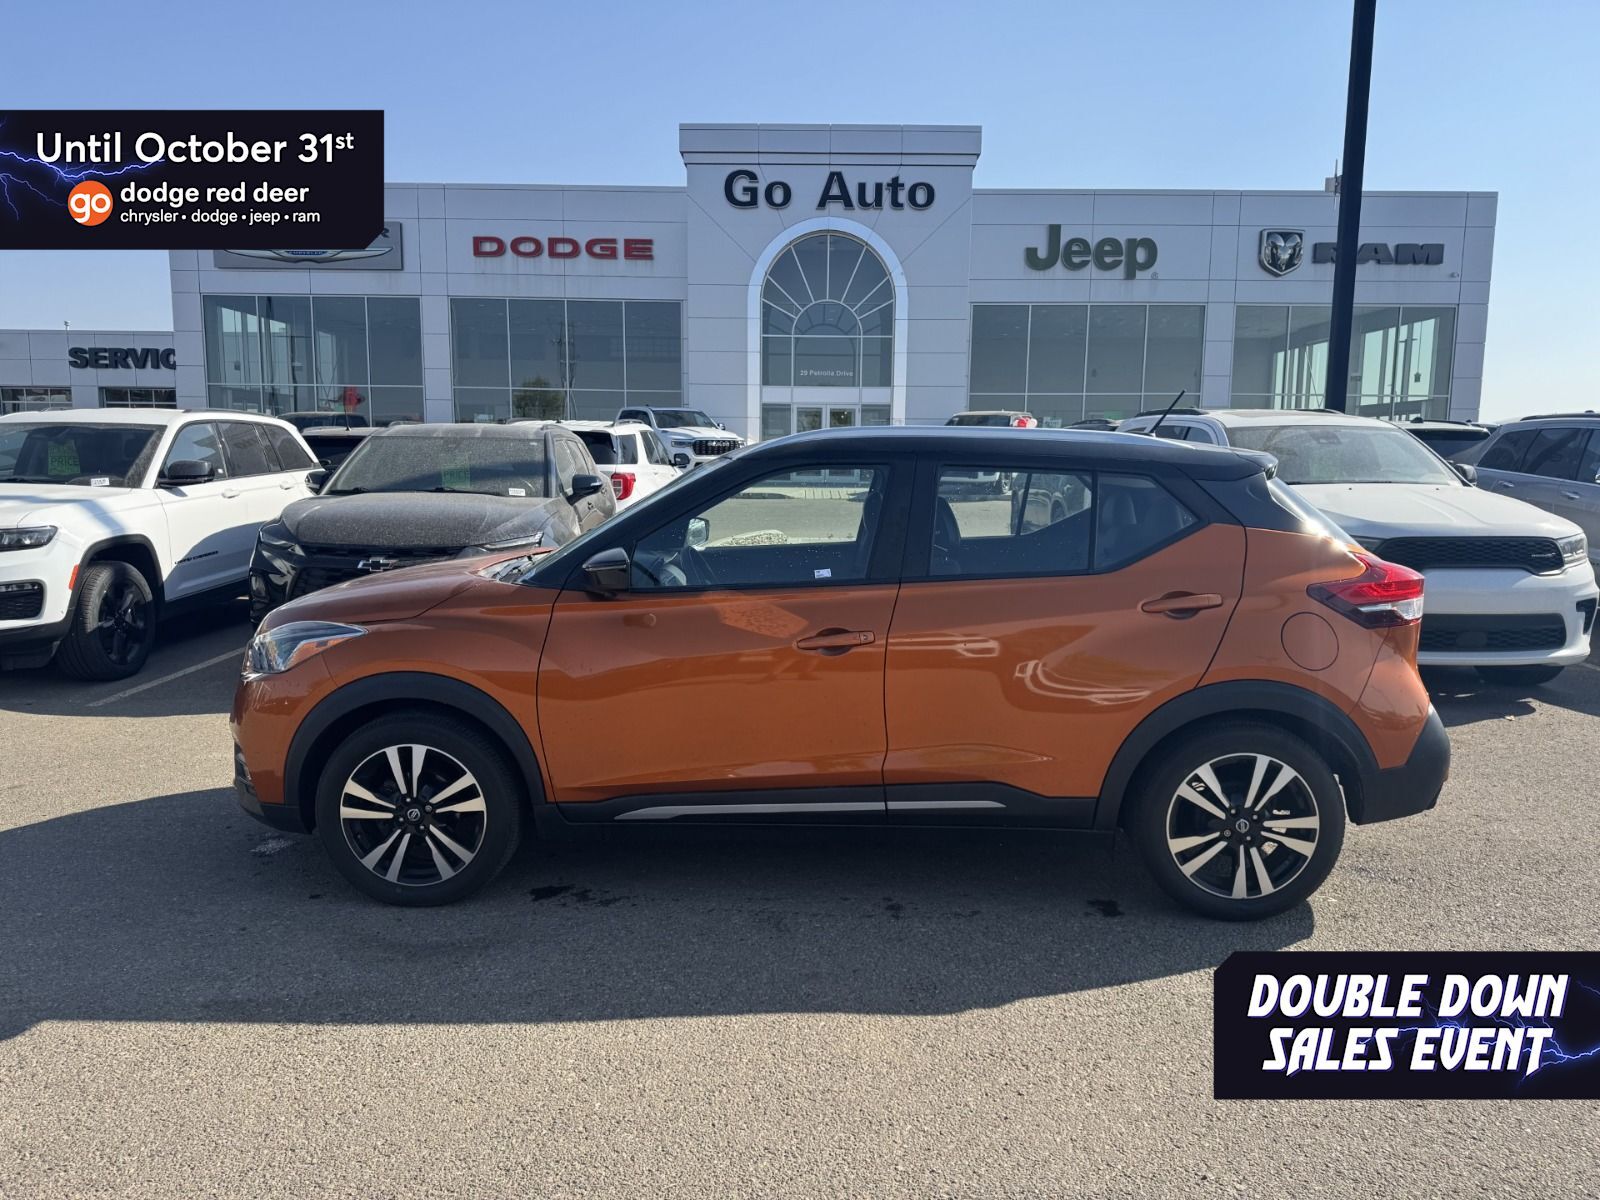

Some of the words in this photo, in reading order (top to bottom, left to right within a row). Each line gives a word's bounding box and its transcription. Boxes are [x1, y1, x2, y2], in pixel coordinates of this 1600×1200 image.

[724, 169, 792, 209] Go
[816, 170, 935, 210] Auto
[472, 235, 654, 260] DODGE
[1025, 224, 1158, 280] Jeep
[50, 456, 80, 466] PRICE
